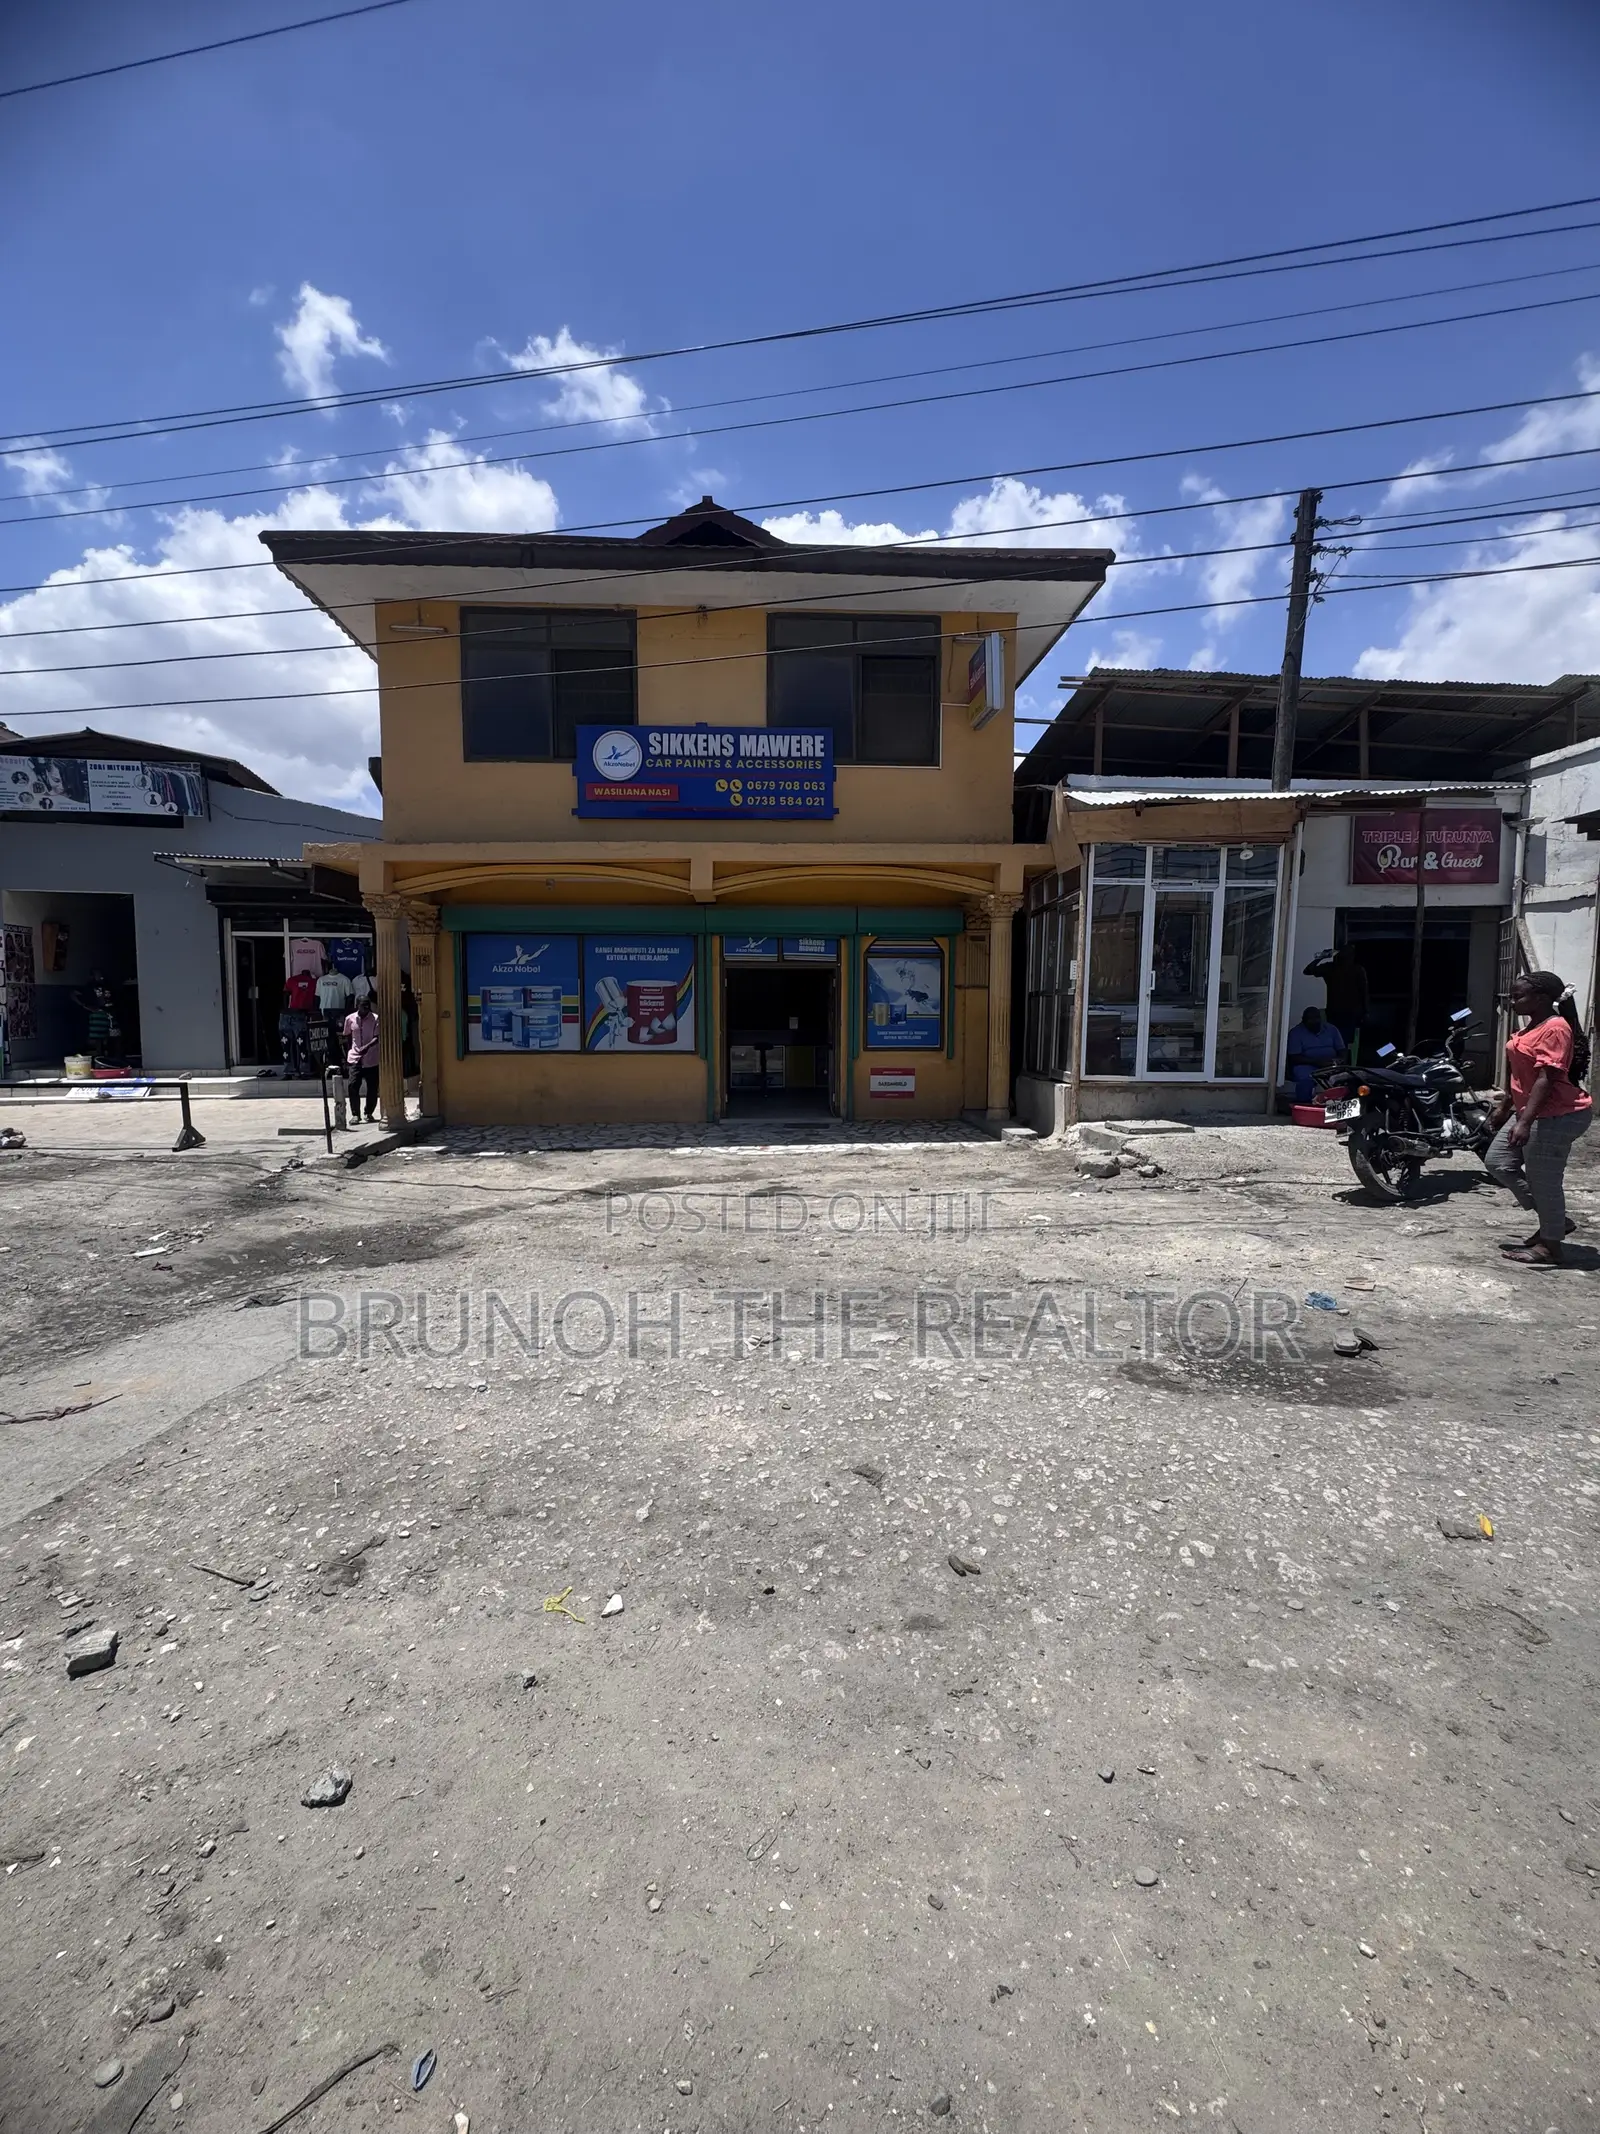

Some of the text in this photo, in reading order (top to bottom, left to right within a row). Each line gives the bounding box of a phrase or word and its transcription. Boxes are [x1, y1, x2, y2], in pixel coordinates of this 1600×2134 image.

[648, 732, 825, 757] SIKKENS MAWERE
[645, 758, 822, 770] CAR PAINTS & ACCESSORIES
[593, 787, 671, 796] WASILIANA NASI
[747, 781, 826, 791] 0679 708 063
[747, 796, 825, 806] 0738 584 021
[1362, 830, 1412, 843] TRIPLE
[1425, 830, 1494, 843] TURUNYA
[1377, 844, 1484, 874] Bar & Guest
[492, 965, 541, 973] Akzo Nobel
